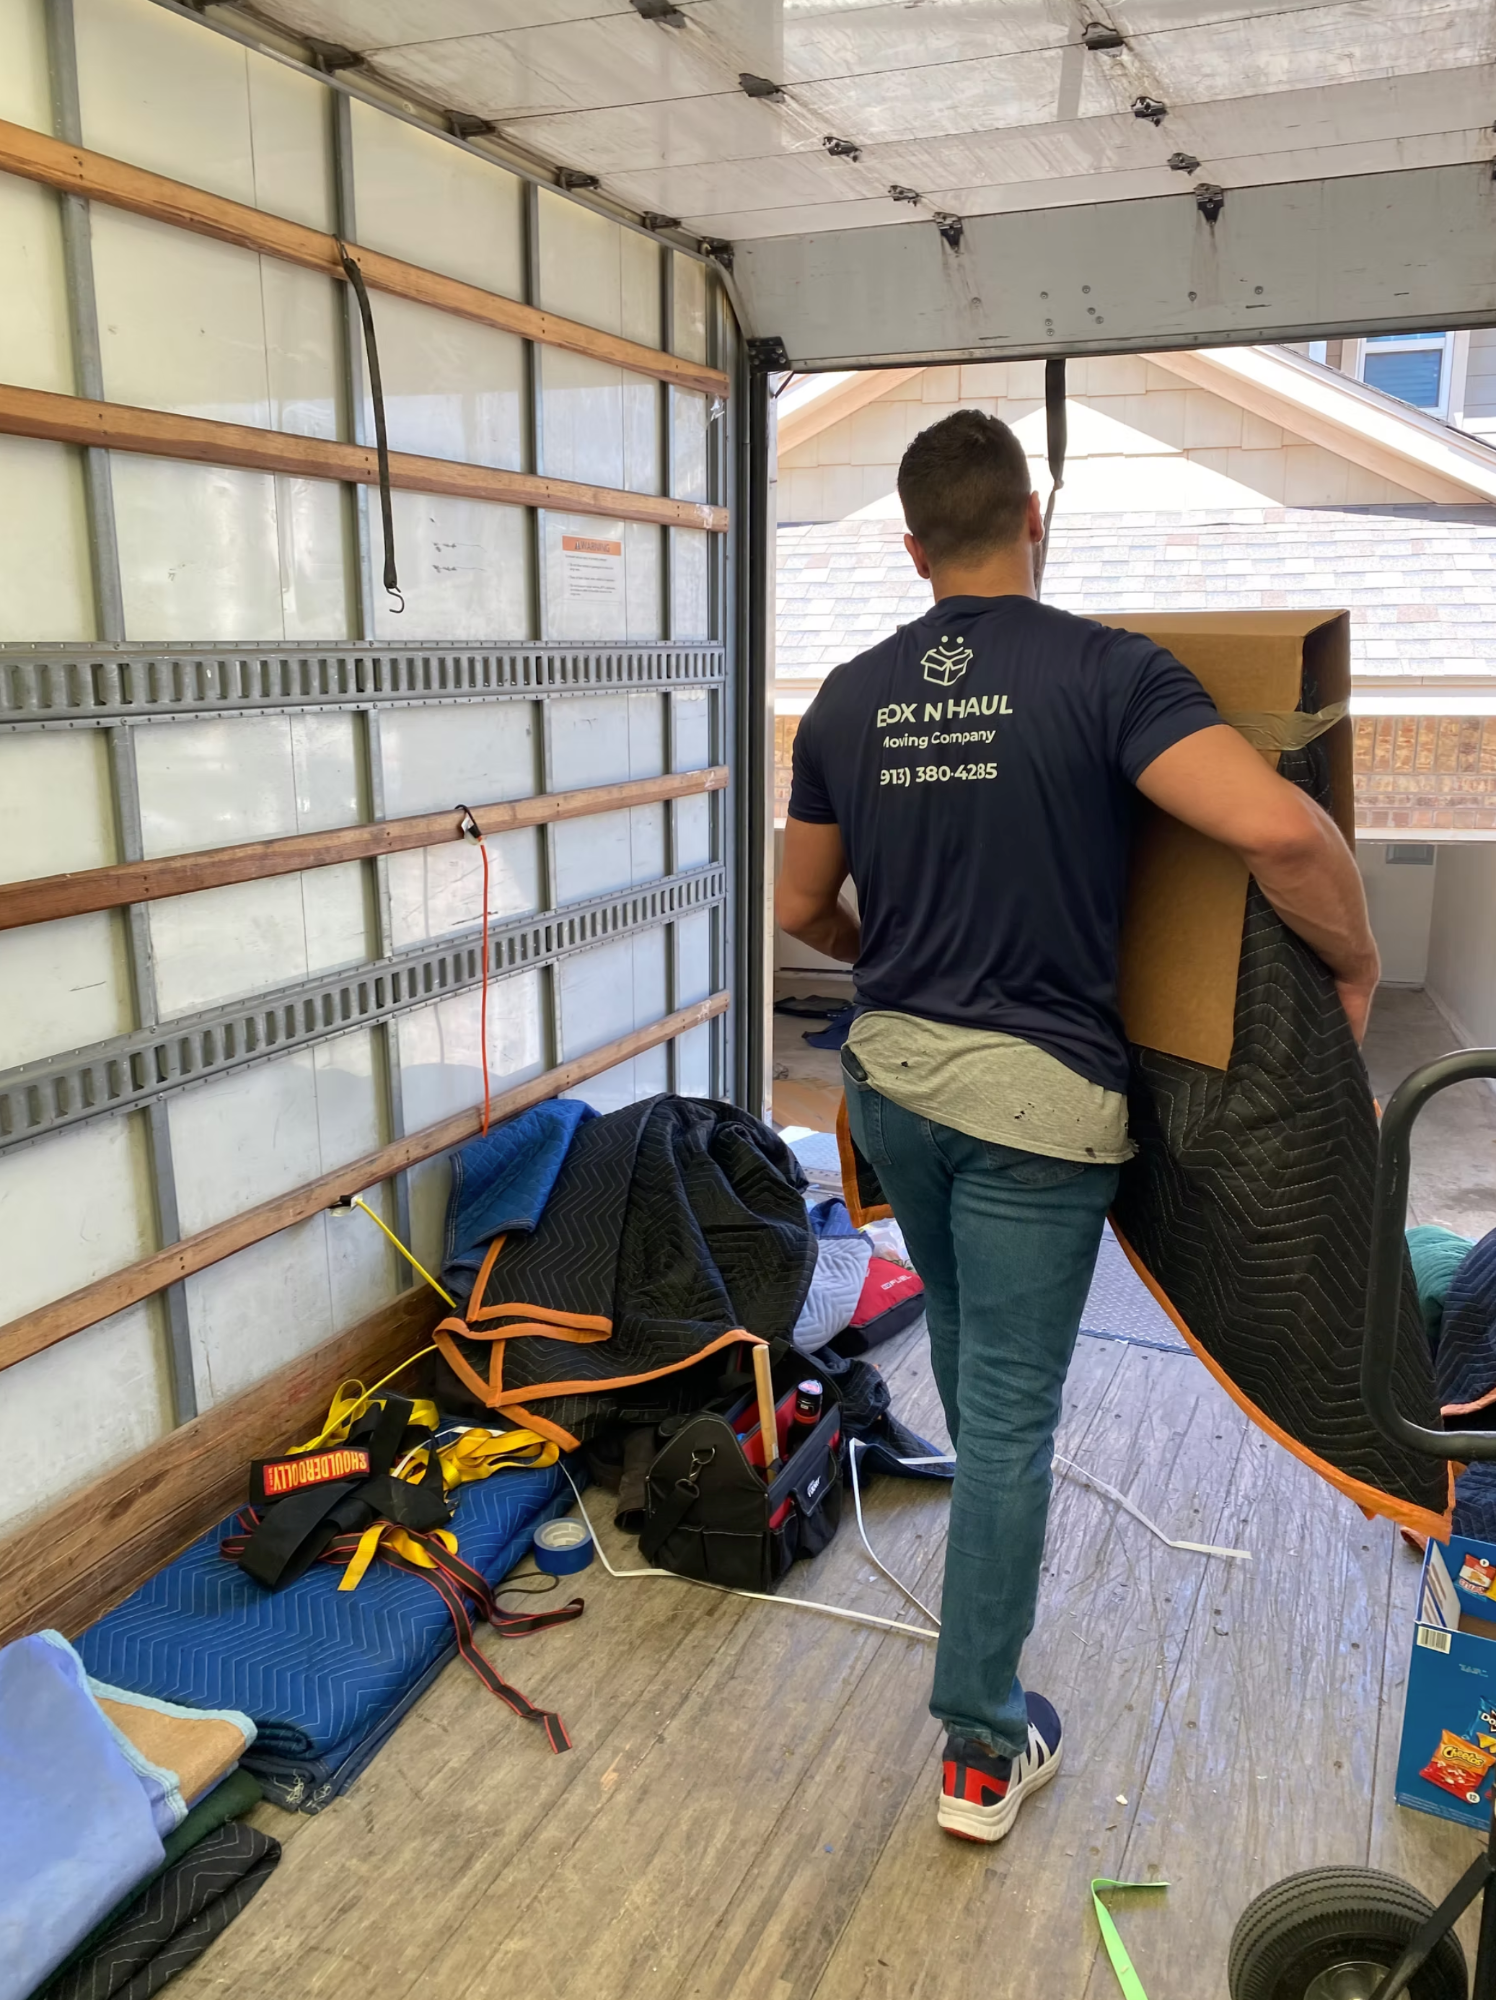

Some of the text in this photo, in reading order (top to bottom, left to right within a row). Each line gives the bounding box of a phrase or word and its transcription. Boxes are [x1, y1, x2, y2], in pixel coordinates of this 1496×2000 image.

[580, 541, 611, 553] WARNING
[923, 702, 943, 722] N
[947, 695, 1013, 719] HAUL
[931, 730, 996, 745] Company
[880, 763, 998, 787] 913) 380-4285
[273, 1451, 367, 1491] SHOULDERDOLLY
[1443, 1746, 1485, 1766] Cheetos
